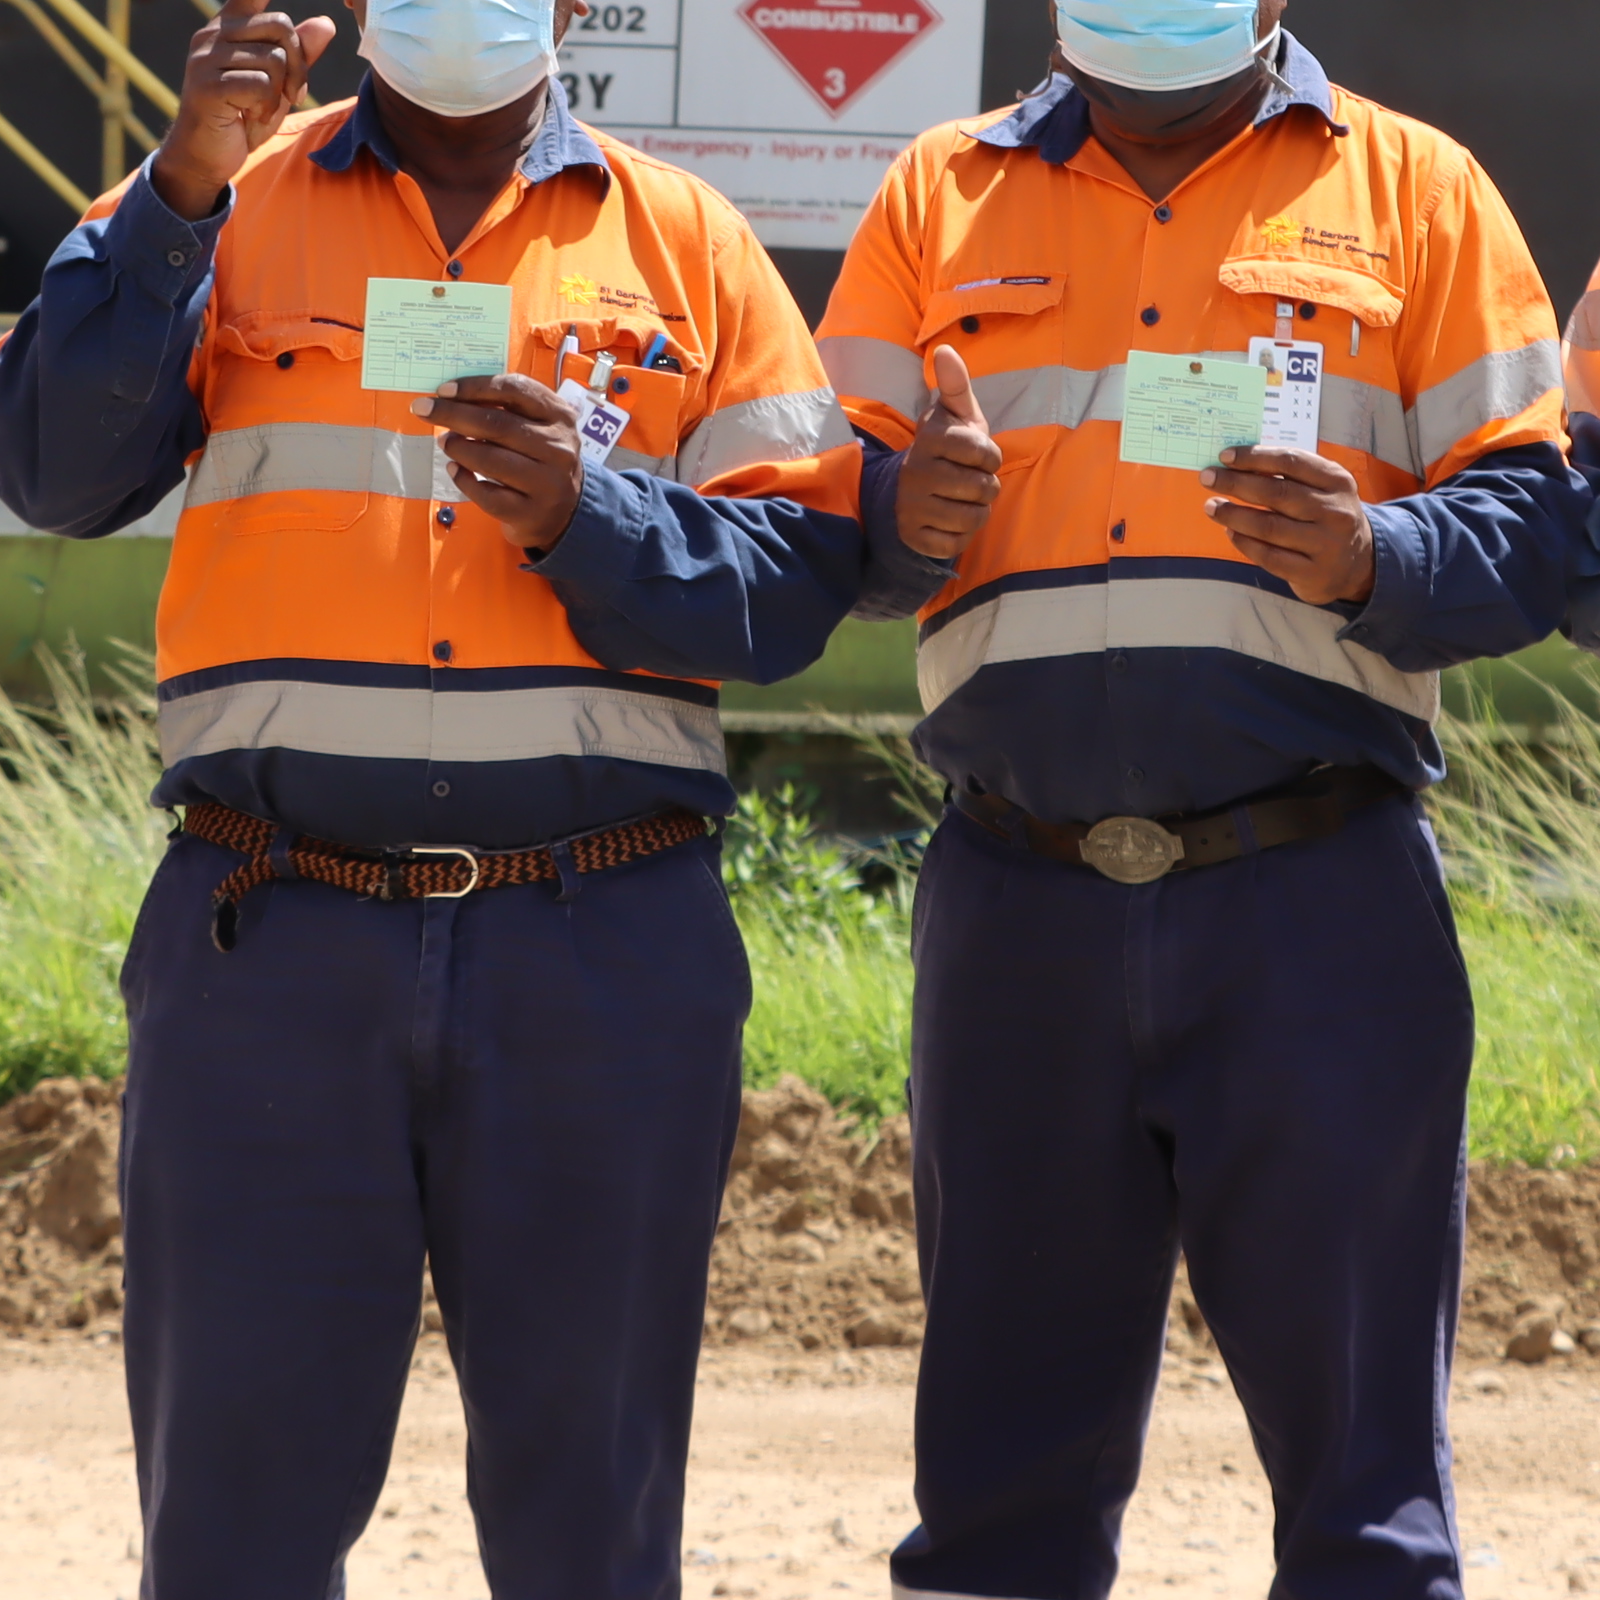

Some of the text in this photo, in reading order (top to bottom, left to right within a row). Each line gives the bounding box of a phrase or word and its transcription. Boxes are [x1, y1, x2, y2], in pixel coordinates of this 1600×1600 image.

[568, 5, 646, 33] 202
[754, 7, 920, 34] COMBUSTIBLE
[824, 67, 846, 99] 3
[643, 137, 753, 159] Emergency
[772, 141, 826, 161] Injury
[832, 144, 851, 157] or
[1287, 356, 1317, 377] CR
[587, 413, 617, 441] CR
